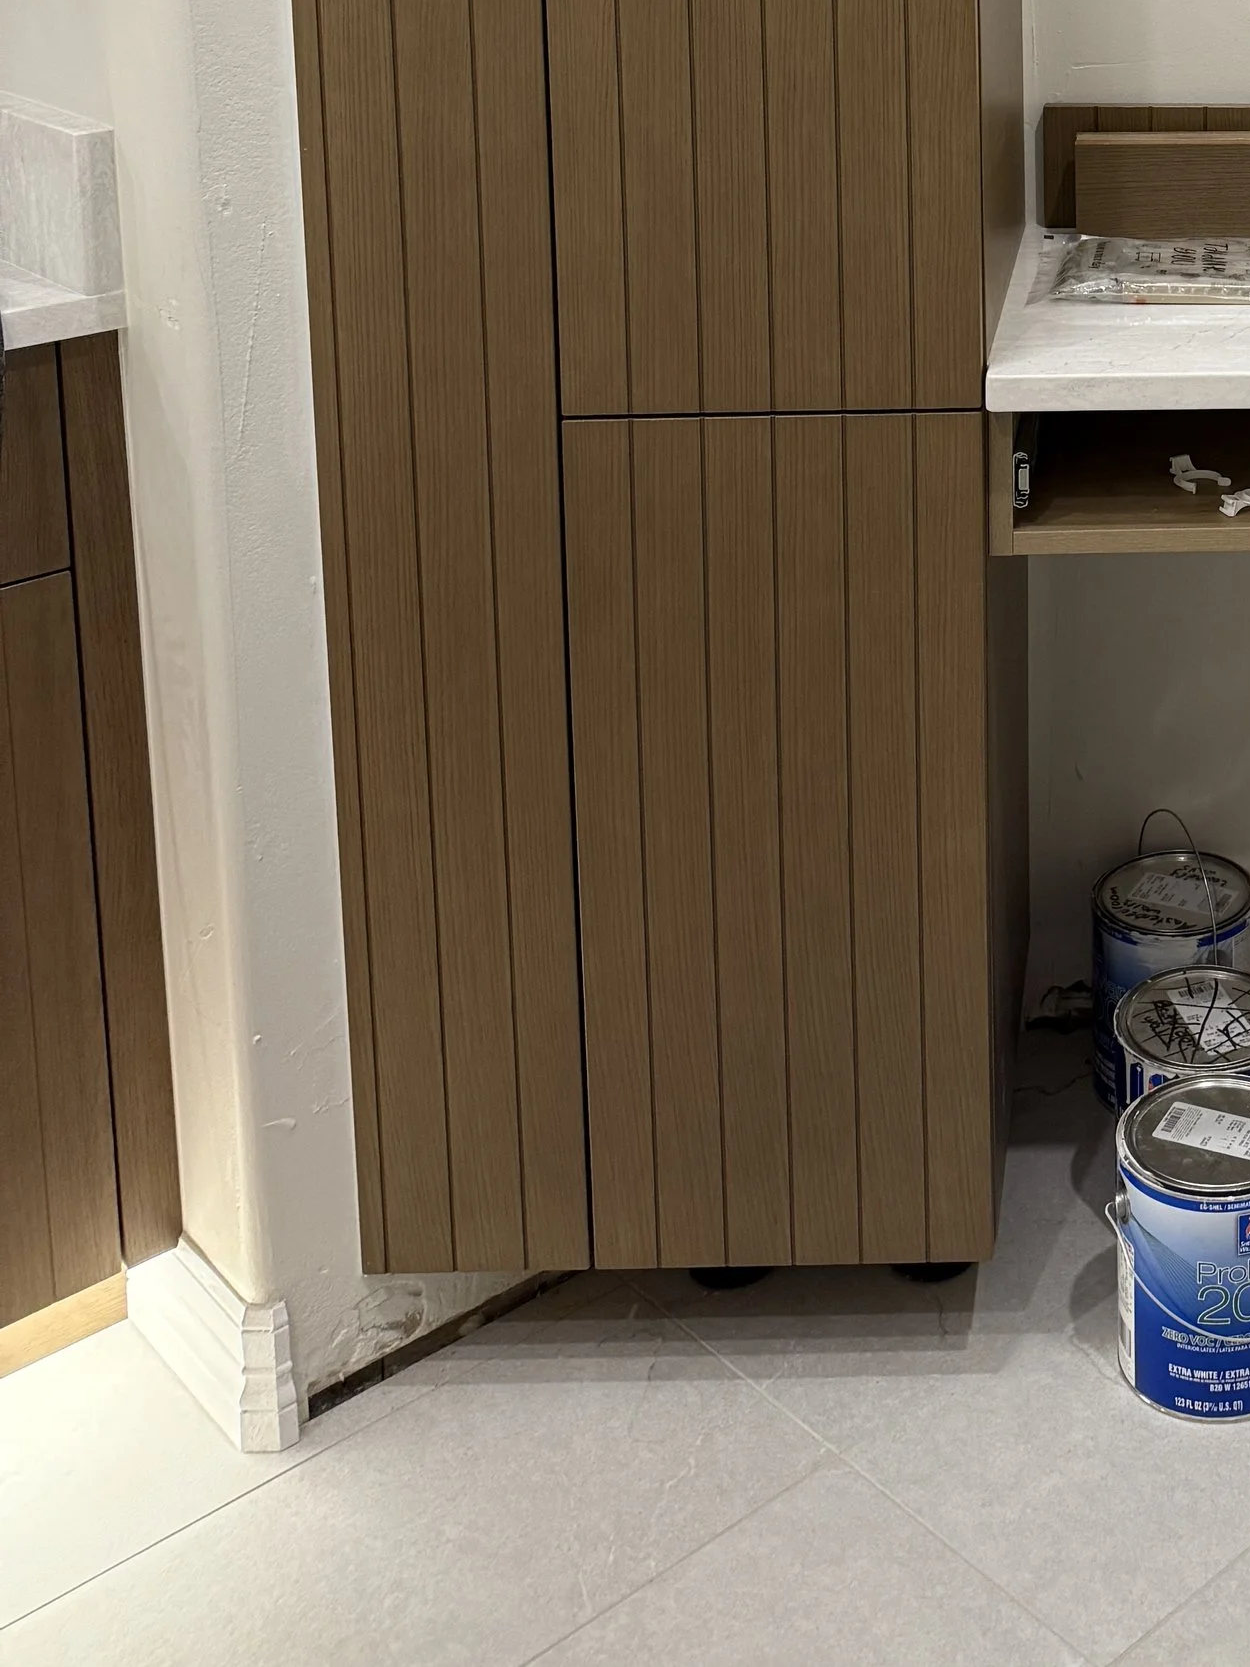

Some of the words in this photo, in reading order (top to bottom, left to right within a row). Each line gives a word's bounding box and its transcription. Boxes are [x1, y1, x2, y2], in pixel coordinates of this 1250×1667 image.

[1190, 1335, 1215, 1347] VOC
[1168, 1363, 1192, 1378] EXTRA
[1193, 1370, 1218, 1380] WHITE
[1225, 1366, 1250, 1380] EXTRA
[1174, 1396, 1185, 1408] 123
[1186, 1399, 1193, 1409] FL
